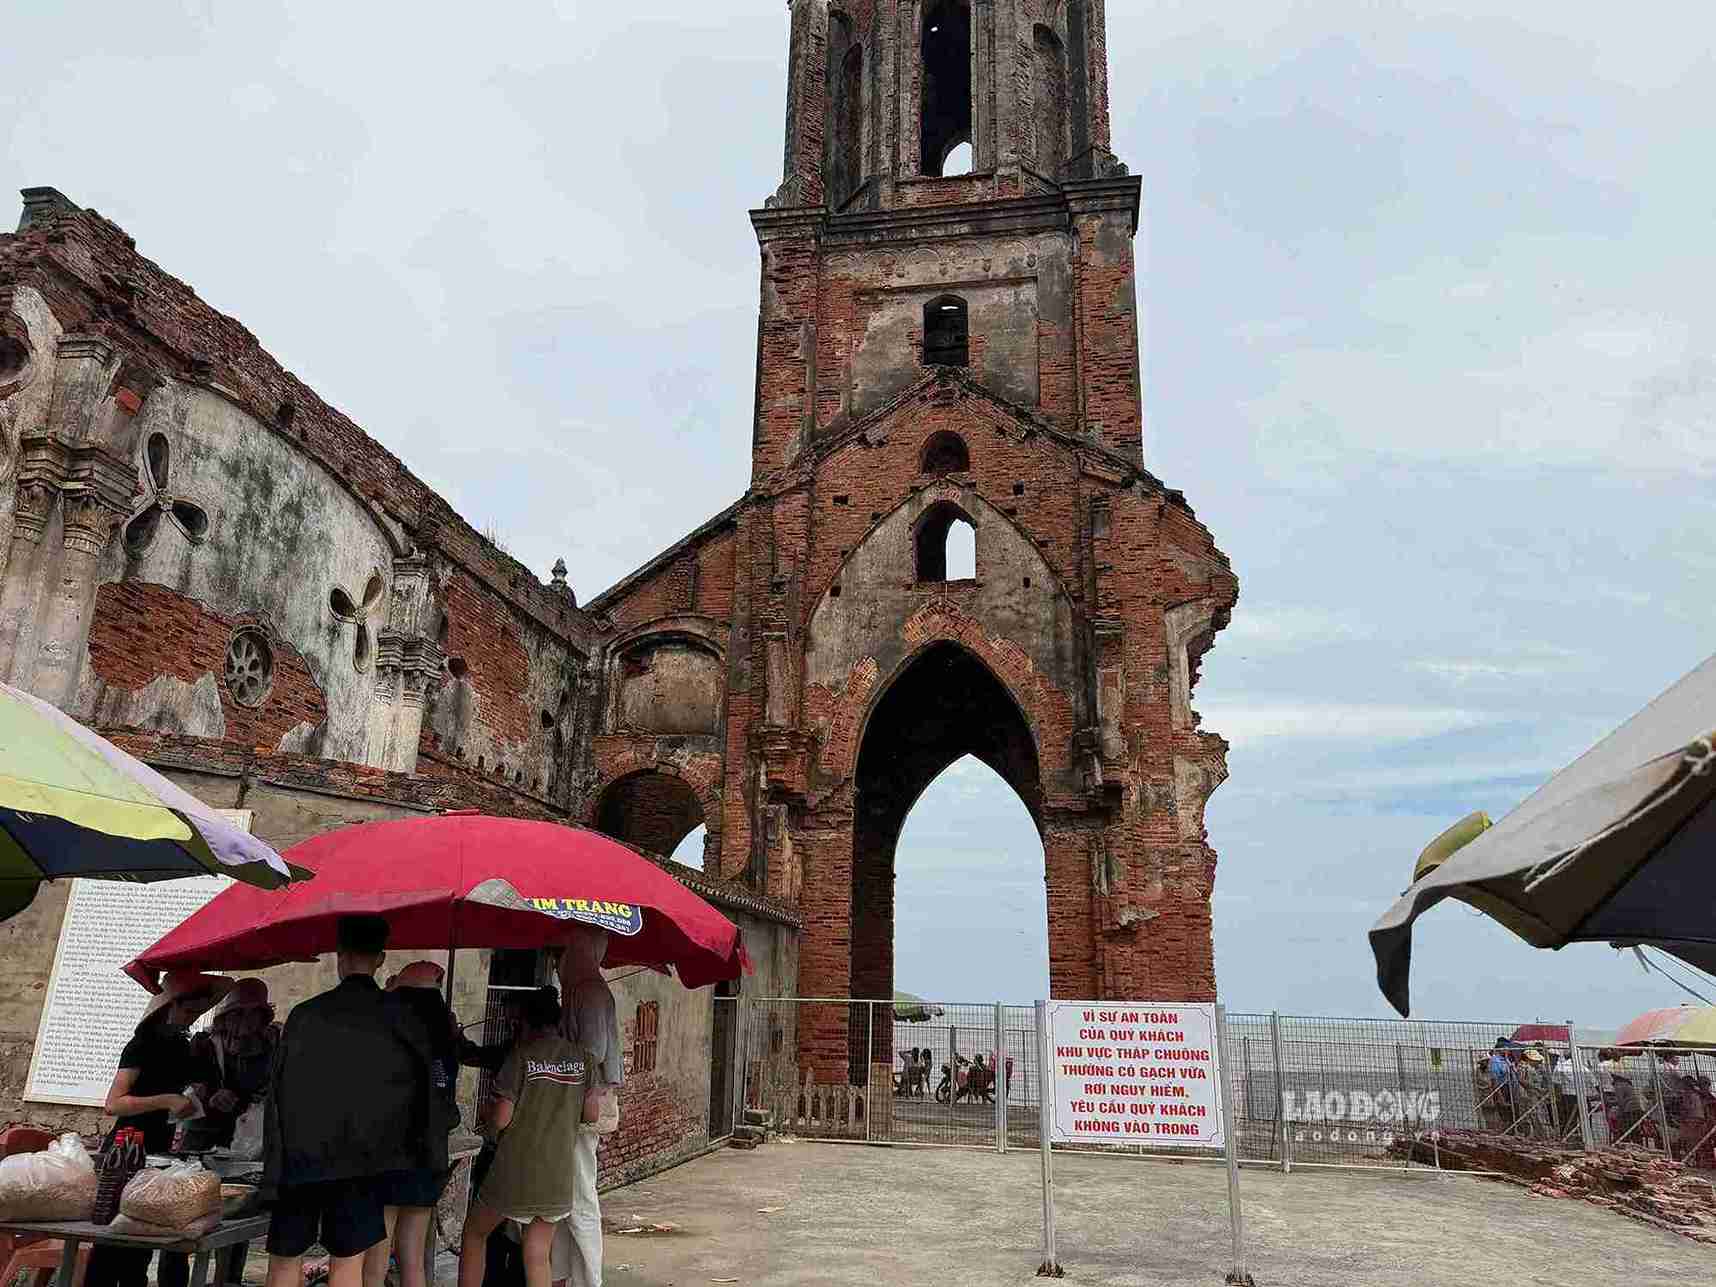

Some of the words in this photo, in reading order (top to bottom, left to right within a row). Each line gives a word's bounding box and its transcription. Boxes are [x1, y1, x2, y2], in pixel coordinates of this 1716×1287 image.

[561, 898, 632, 919] TRANG
[1121, 1012, 1139, 1024] AN
[1079, 1025, 1106, 1041] CỦA
[1056, 1046, 1083, 1058] KHU
[1111, 1084, 1146, 1097] NGUY
[1154, 1122, 1199, 1136] TRONG
